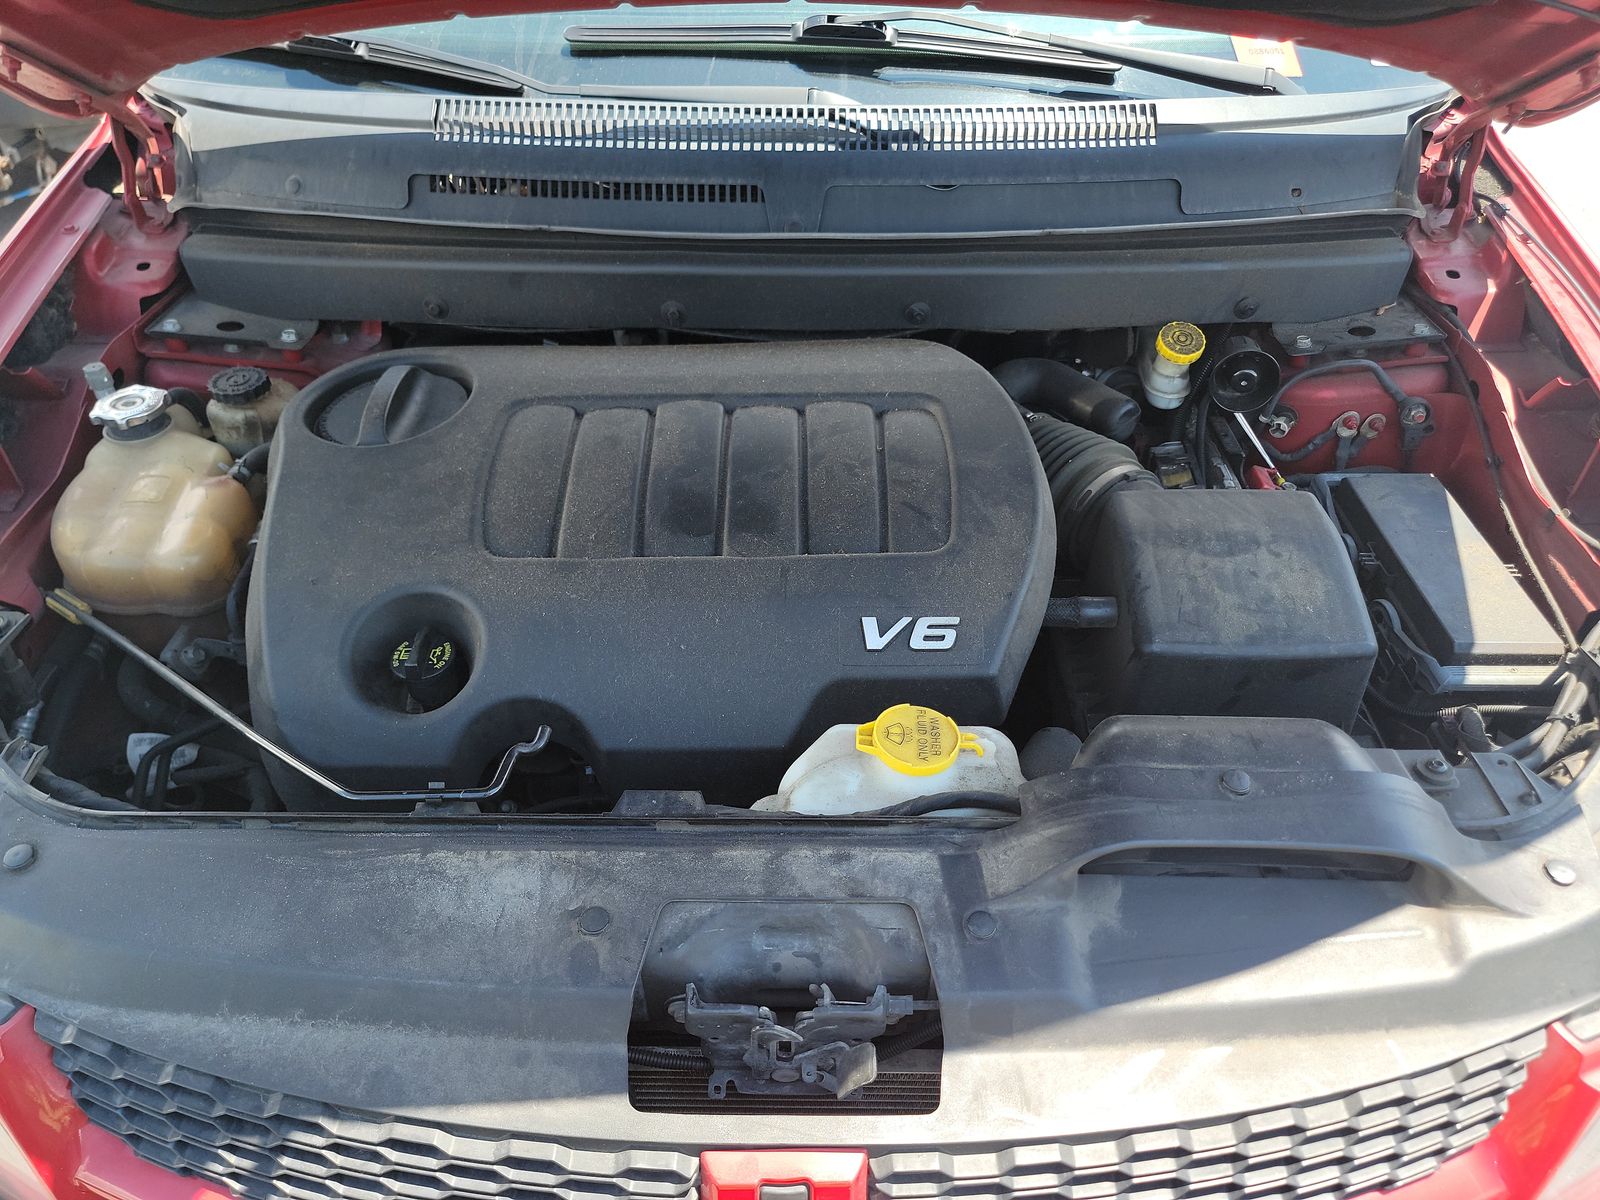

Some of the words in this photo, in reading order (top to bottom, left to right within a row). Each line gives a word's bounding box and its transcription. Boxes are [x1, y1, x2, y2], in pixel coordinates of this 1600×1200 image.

[861, 616, 960, 650] V6
[434, 660, 446, 669] OIL
[442, 642, 452, 661] ENGINE
[916, 708, 927, 736] FLUID
[917, 737, 929, 763] ONLY
[929, 716, 942, 757] WASHER
